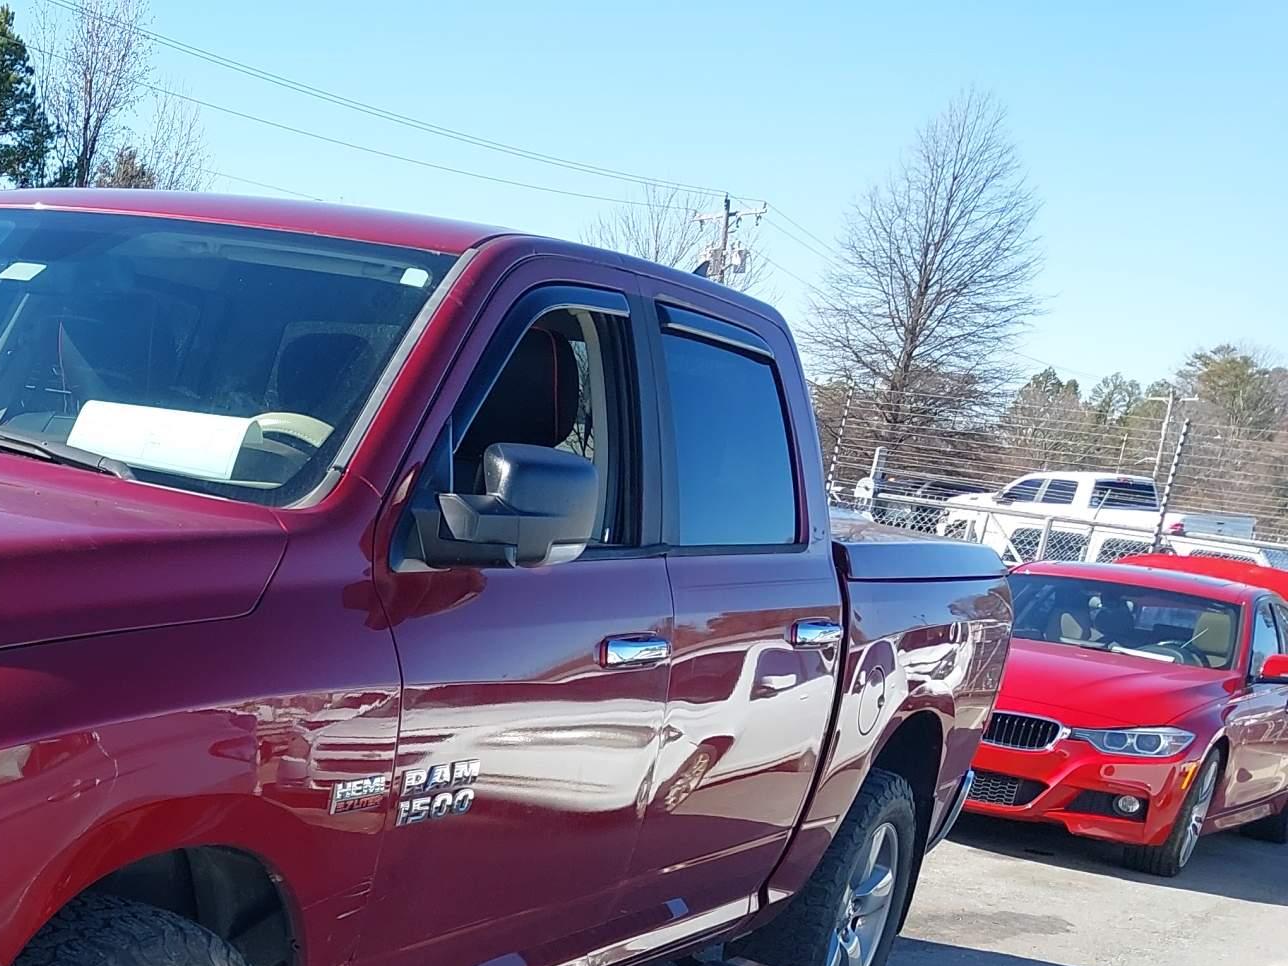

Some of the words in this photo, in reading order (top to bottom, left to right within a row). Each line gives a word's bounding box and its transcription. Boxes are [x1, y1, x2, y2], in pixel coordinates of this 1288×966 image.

[335, 776, 386, 800] HEMI
[402, 758, 481, 796] RAM
[395, 787, 475, 827] 1500
